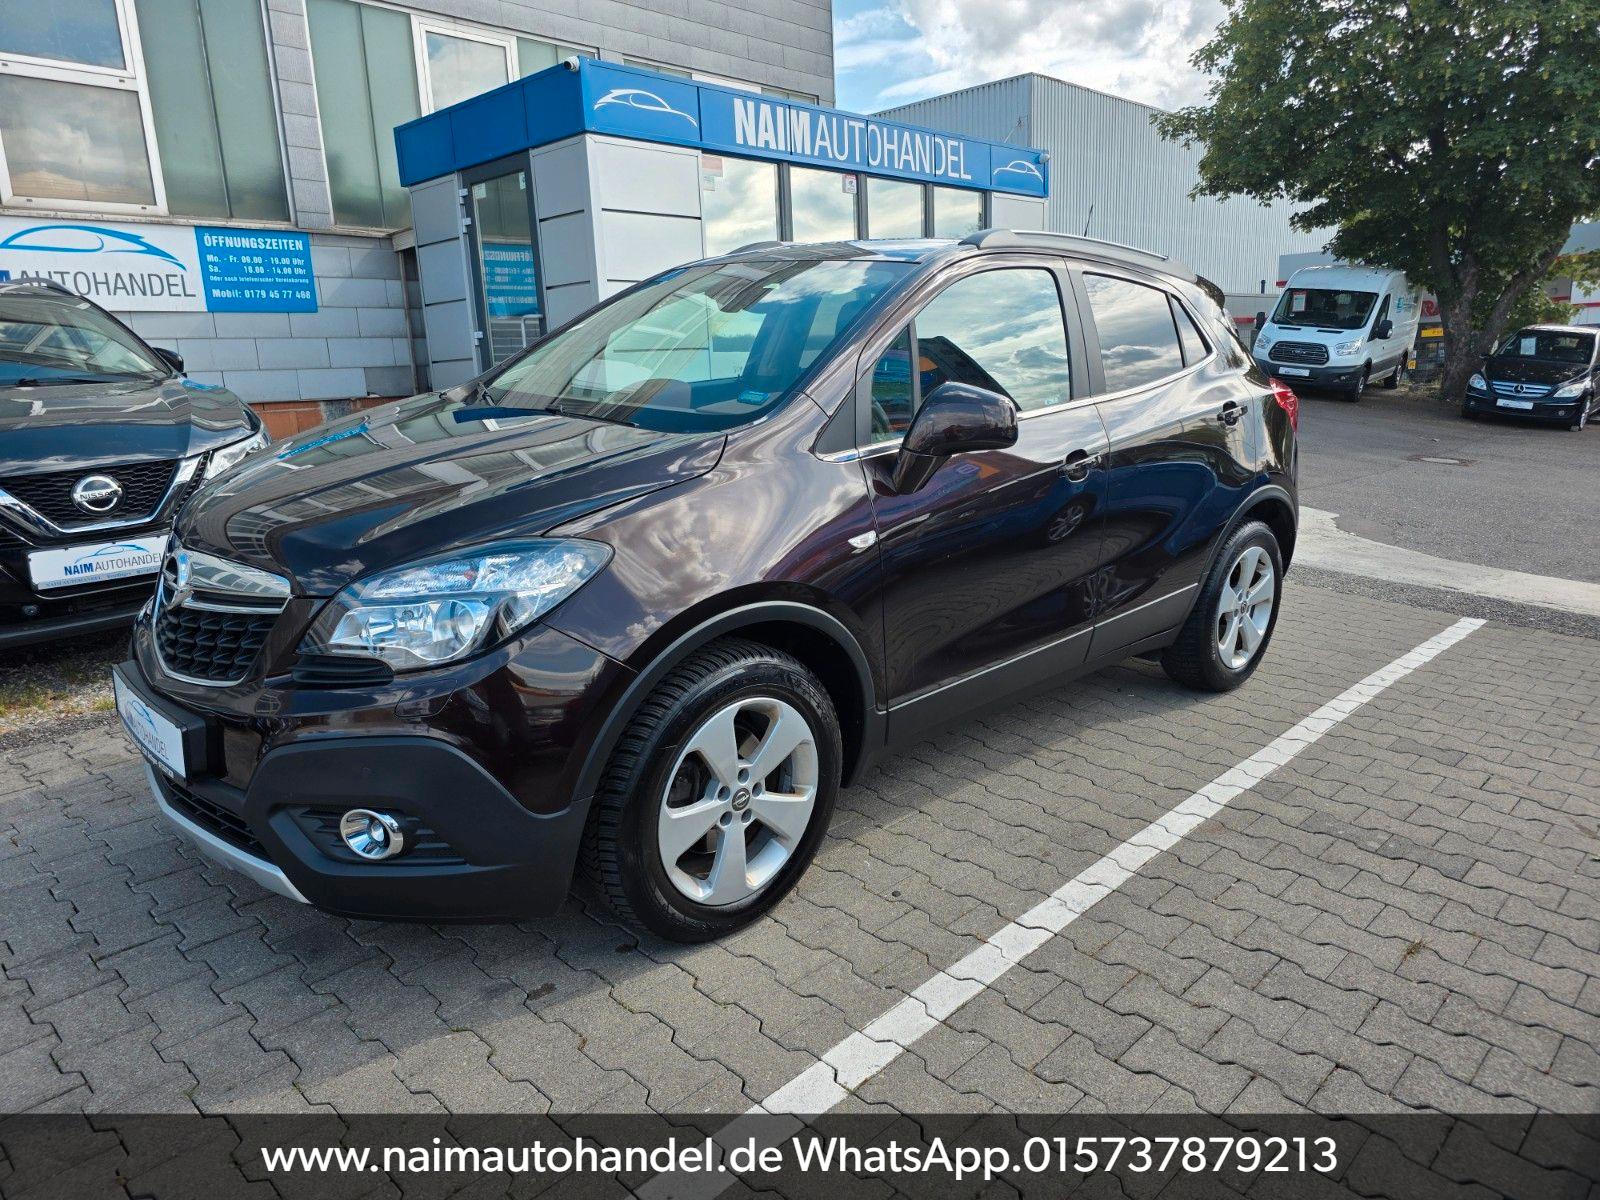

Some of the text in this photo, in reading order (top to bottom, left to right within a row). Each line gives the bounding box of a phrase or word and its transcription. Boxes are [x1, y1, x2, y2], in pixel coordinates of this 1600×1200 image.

[203, 233, 303, 250] ÖFFNUNGSZEITEN
[206, 254, 221, 263] Mo.
[229, 255, 240, 264] Fr.
[292, 257, 305, 266] Uhr
[208, 264, 222, 273] Sa.
[294, 267, 306, 275] Uhr
[211, 289, 242, 298] Mobil:
[243, 289, 267, 299] 0179
[269, 290, 280, 299] 45
[281, 290, 293, 299] 77
